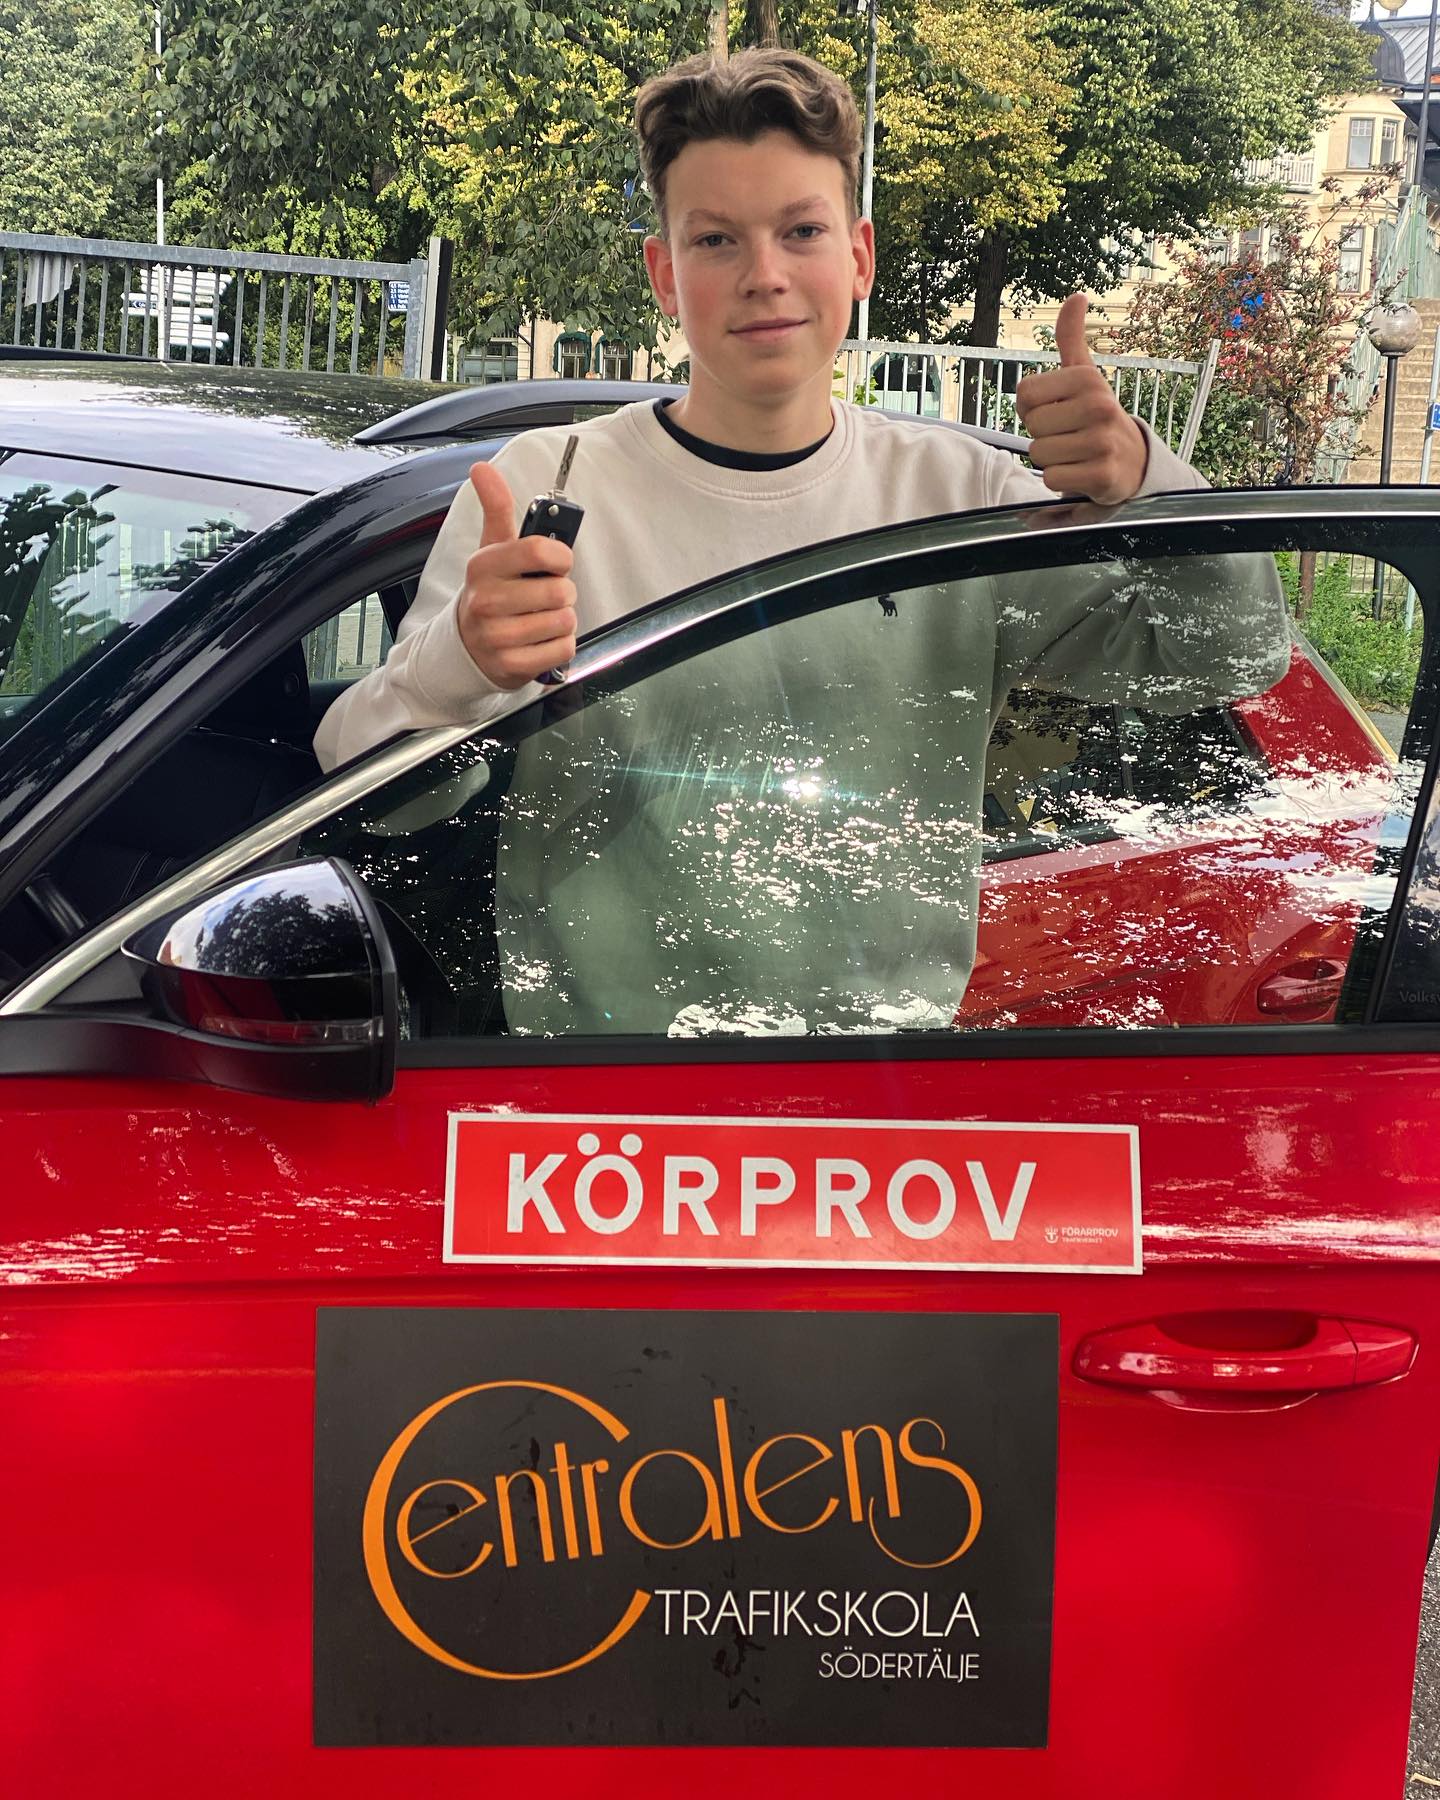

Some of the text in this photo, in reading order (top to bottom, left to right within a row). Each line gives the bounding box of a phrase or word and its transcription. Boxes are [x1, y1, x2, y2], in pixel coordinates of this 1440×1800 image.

[506, 1132, 1037, 1241] KÖRPROV
[363, 1380, 983, 1680] Centralens
[654, 1589, 980, 1638] TRAFIKSKOLA
[818, 1645, 980, 1683] SÖDERTÄLJE
